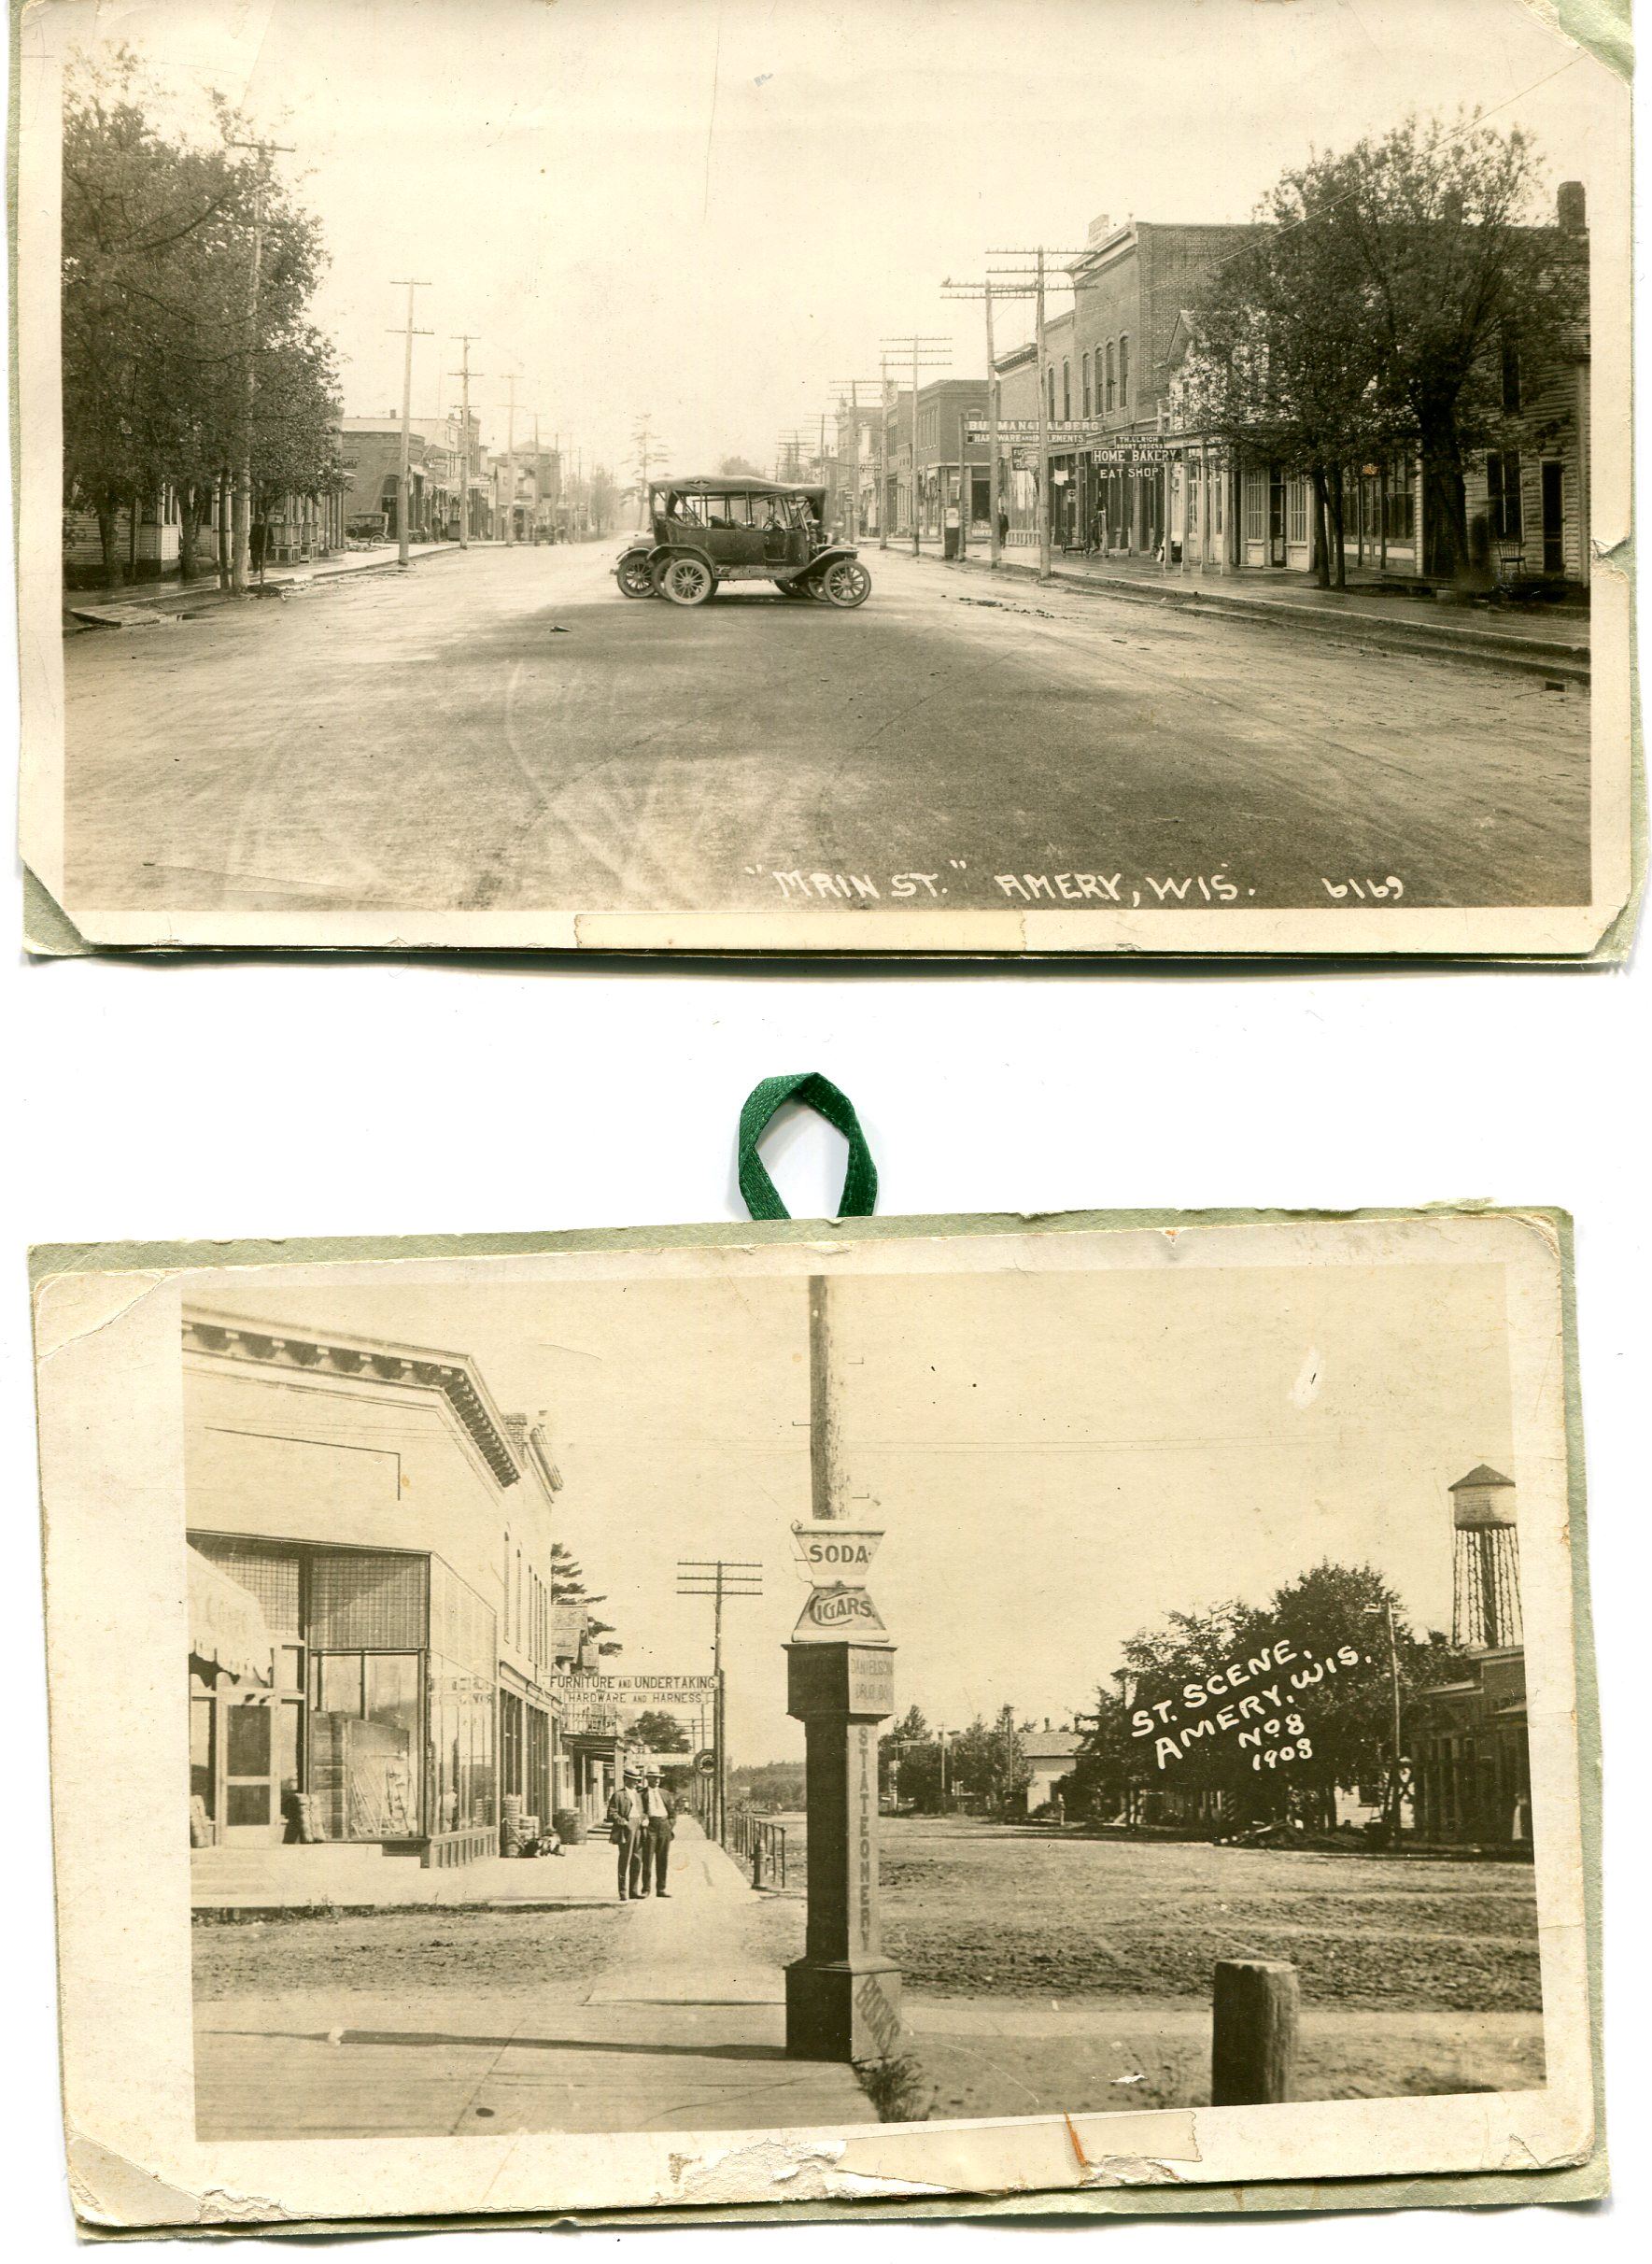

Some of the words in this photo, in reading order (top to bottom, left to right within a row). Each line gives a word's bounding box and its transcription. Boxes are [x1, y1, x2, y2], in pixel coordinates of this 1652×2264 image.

[968, 421, 1026, 431] BUMAN
[1094, 450, 1125, 461] HOME
[1132, 449, 1177, 461] BAKERY
[1100, 469, 1123, 478] EAT
[550, 1677, 615, 1689] FURNITURE
[618, 1679, 632, 1688] AND
[569, 1692, 627, 1703] HARDWARE
[653, 1692, 702, 1703] HARNESS
